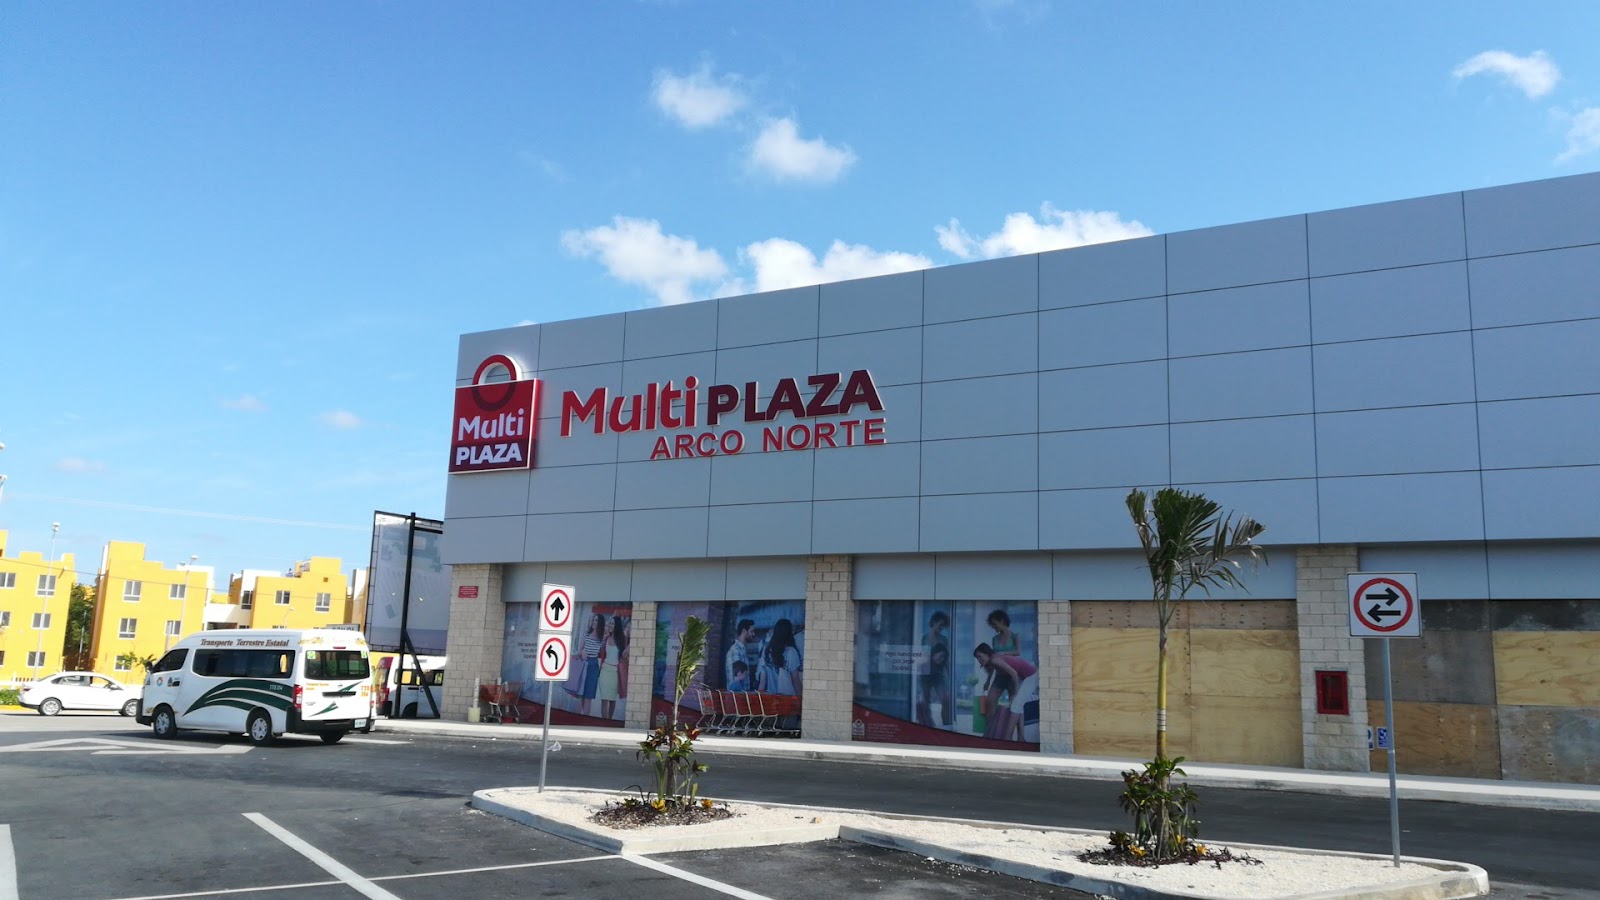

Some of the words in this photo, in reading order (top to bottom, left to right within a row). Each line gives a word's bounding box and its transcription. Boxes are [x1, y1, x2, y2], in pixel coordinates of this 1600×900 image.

[458, 408, 524, 441] Multi
[650, 429, 745, 460] ARCO
[762, 417, 886, 452] NORTE
[455, 442, 522, 466] PLAZA
[200, 638, 233, 647] Transporte
[236, 638, 265, 646] Terrestre
[265, 639, 290, 647] Estatal
